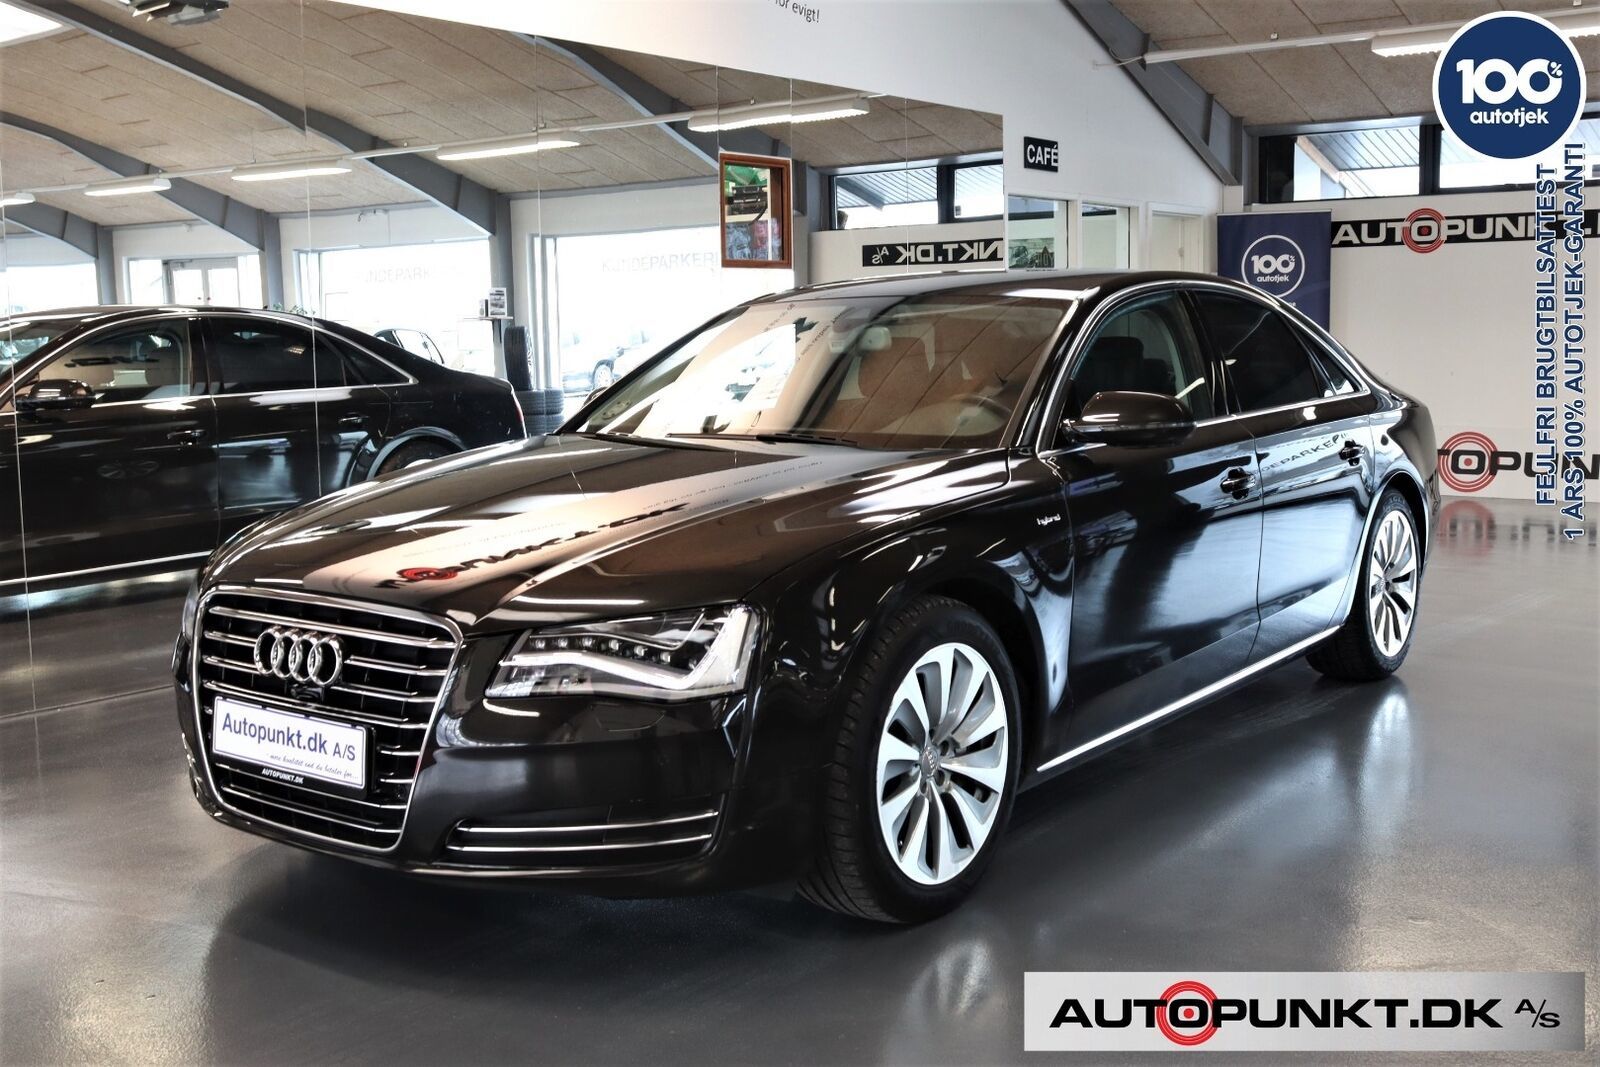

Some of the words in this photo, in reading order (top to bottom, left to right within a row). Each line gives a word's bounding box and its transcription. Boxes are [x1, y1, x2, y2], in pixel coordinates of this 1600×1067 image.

[791, 2, 820, 23] evigt!
[1026, 144, 1058, 167] CAFÉ
[1256, 273, 1290, 283] autotjek
[222, 712, 328, 755] Autopunkt.dk
[333, 742, 356, 761] A/S
[261, 768, 304, 784] AUTOPUNKT.DK
